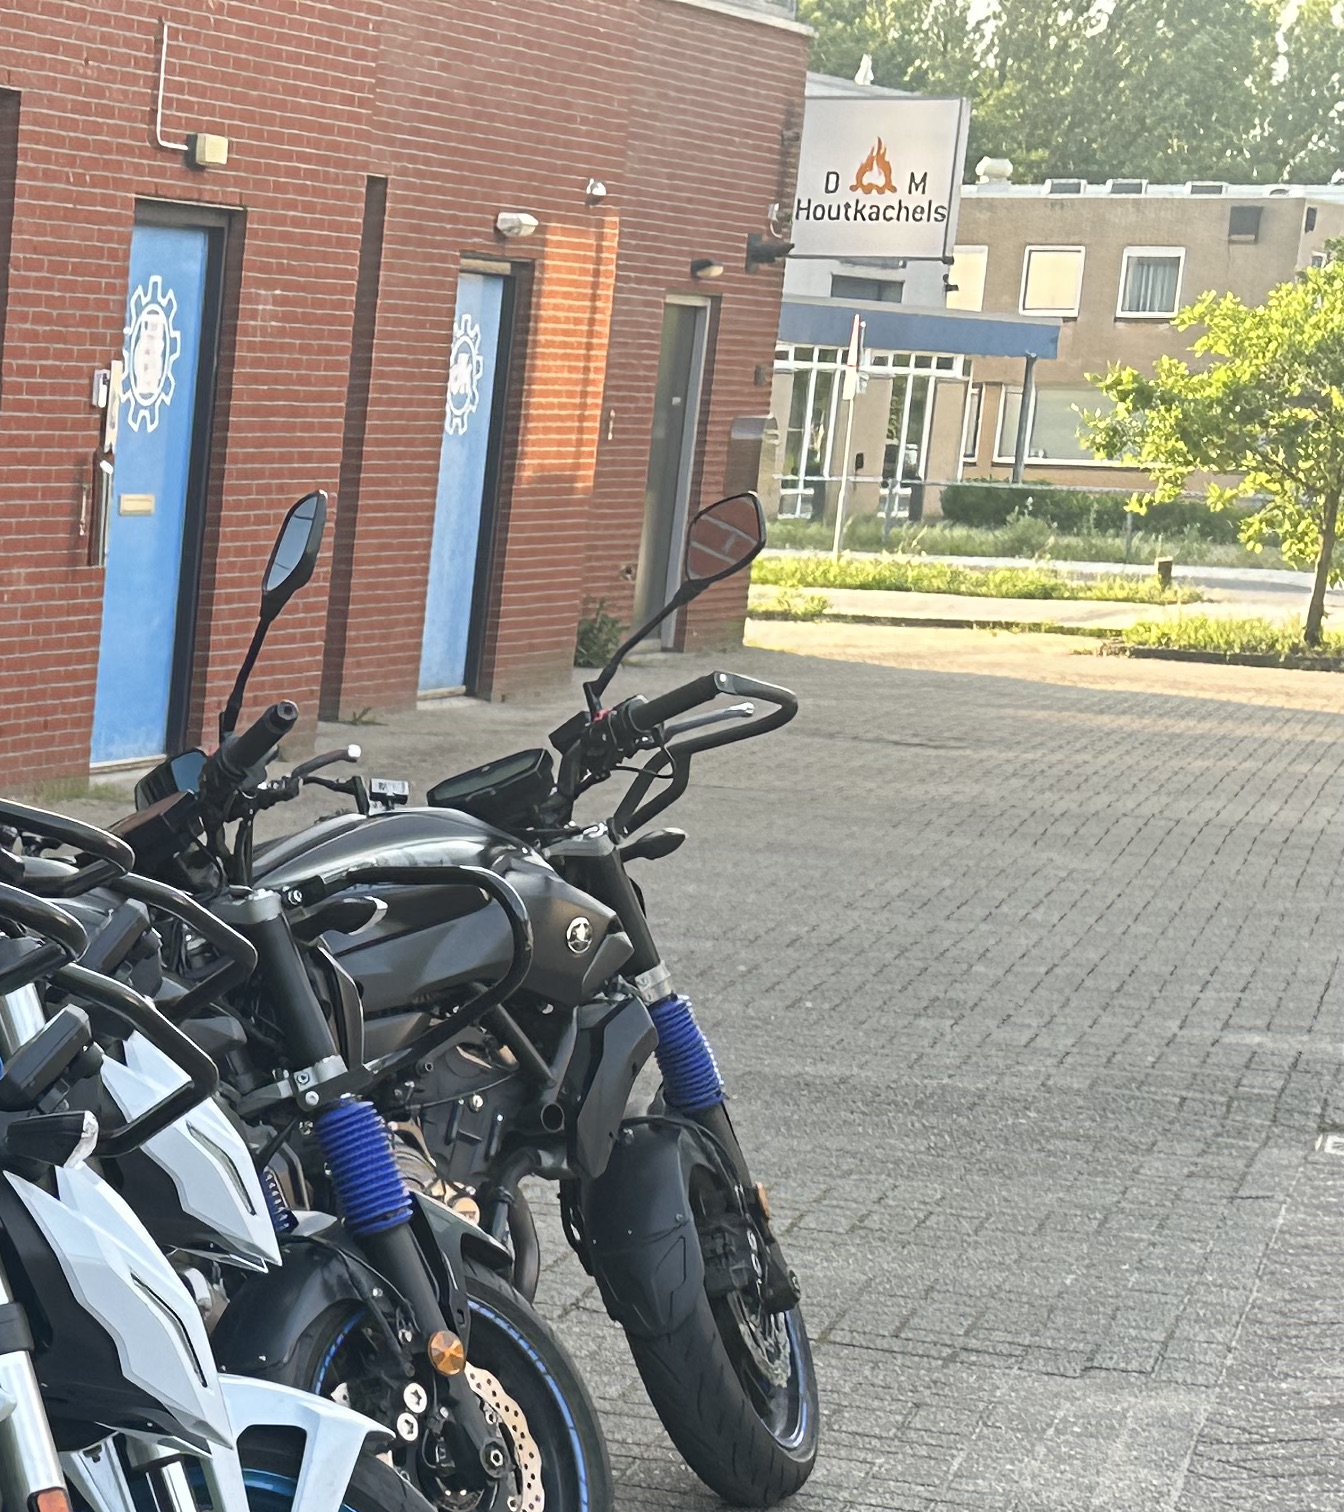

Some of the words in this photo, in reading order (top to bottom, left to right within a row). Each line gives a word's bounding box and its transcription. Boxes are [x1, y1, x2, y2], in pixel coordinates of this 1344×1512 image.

[824, 171, 840, 195] D
[908, 171, 928, 195] M
[794, 198, 948, 223] Houtkachels
